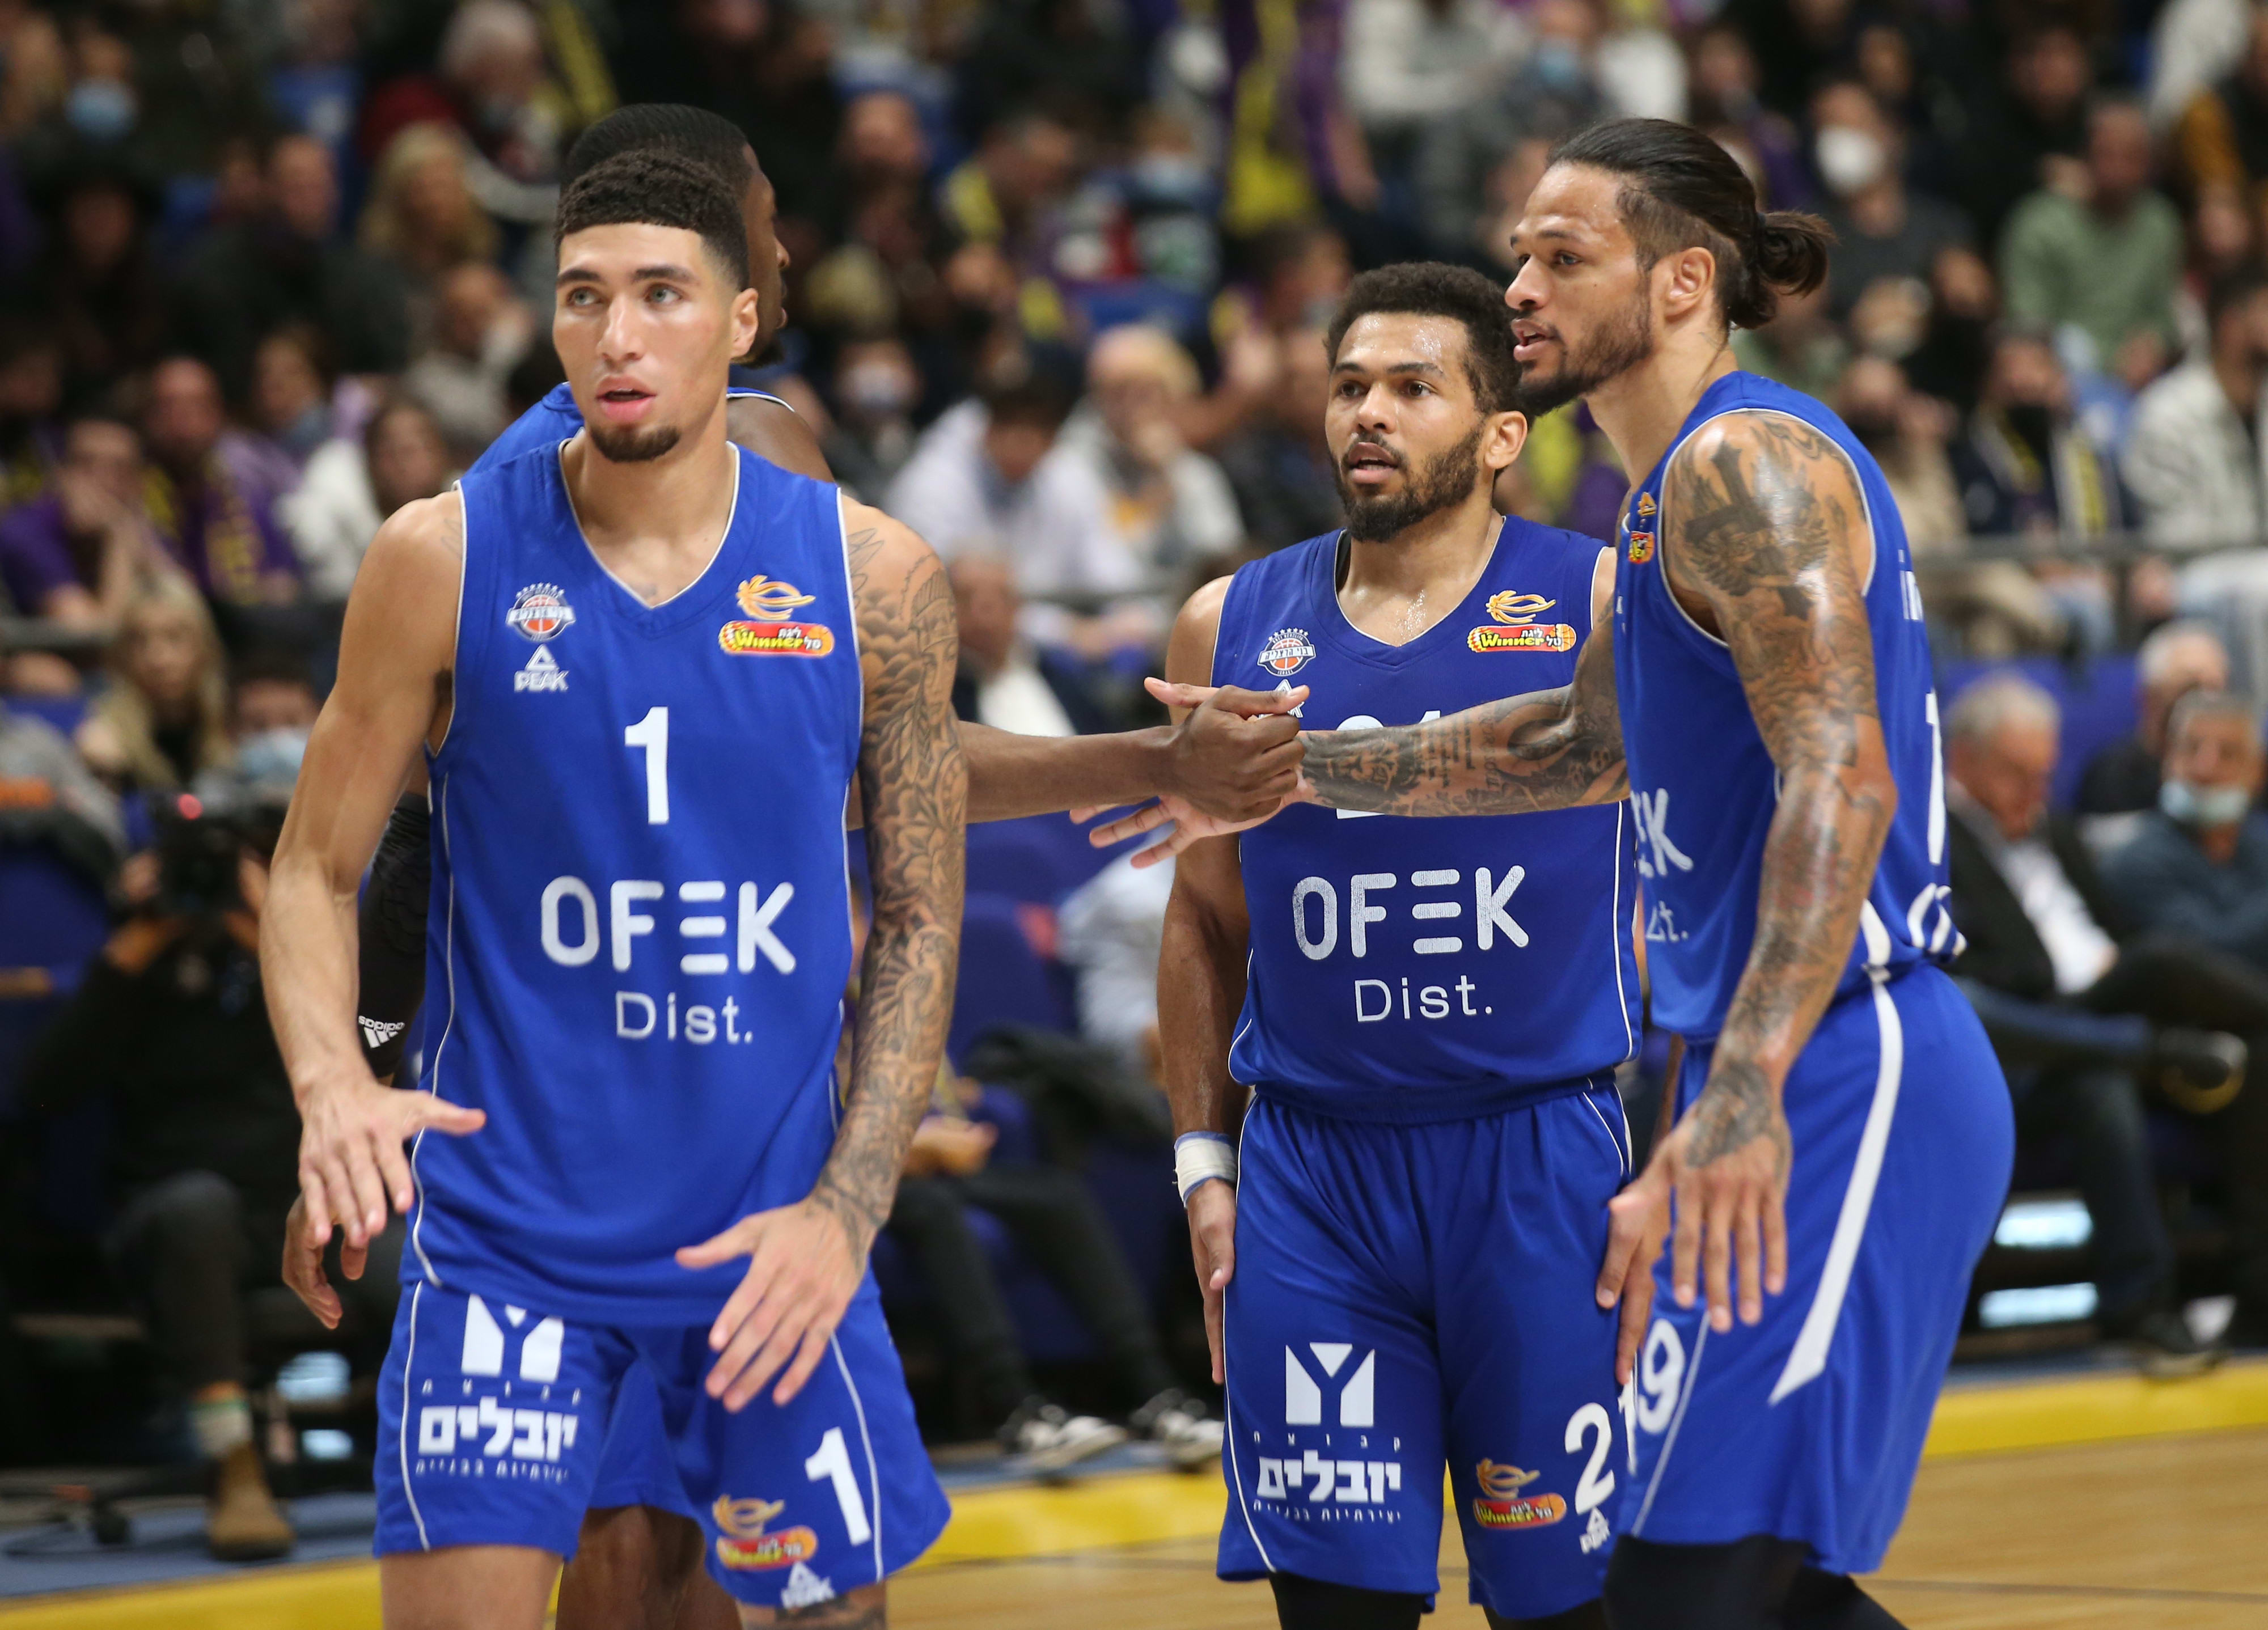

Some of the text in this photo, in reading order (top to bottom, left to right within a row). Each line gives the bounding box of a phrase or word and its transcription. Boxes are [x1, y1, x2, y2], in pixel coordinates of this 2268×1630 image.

[734, 629, 803, 649] Winner
[1480, 633, 1545, 648] Winner
[1521, 628, 1543, 638] ליגת
[514, 669, 569, 692] PEAK
[625, 706, 670, 825] 1
[541, 875, 796, 975] OFEK
[1292, 865, 1529, 960] OFEK
[358, 1015, 405, 1032] adidas
[616, 992, 752, 1044] Dist.
[1355, 975, 1492, 1022] Dist.
[418, 1395, 579, 1463] יובלים
[805, 1426, 871, 1546] 1
[1256, 1449, 1401, 1504] יובלים
